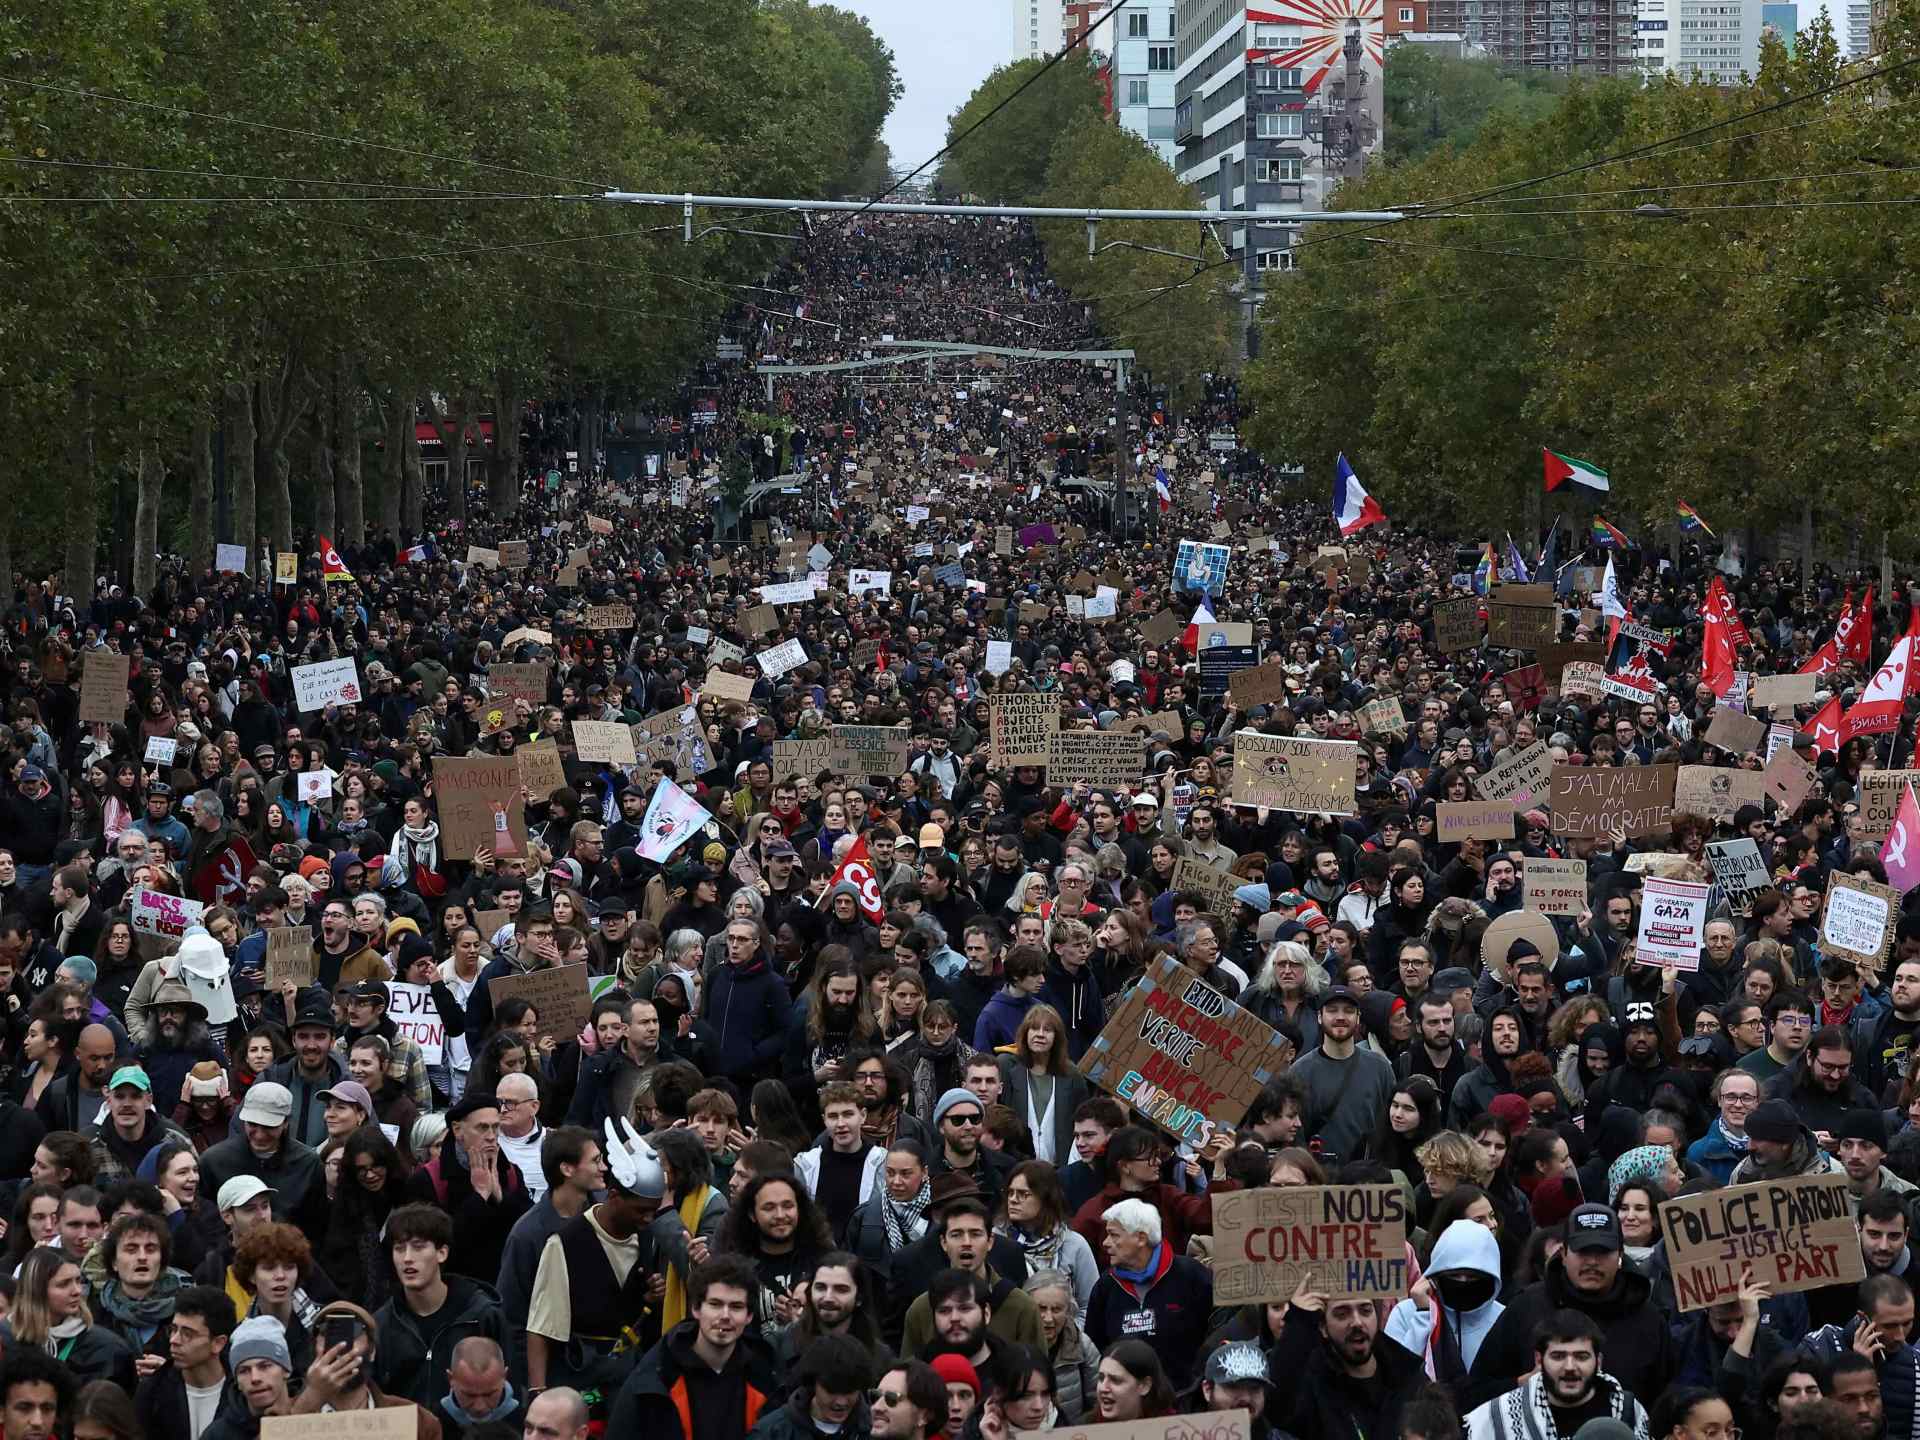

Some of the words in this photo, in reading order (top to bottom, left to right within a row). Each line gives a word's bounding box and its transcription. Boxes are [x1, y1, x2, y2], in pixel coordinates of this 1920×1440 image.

[997, 705, 1057, 715] FRAUDEURS
[997, 715, 1044, 726] ABJECTS
[997, 725, 1050, 736] CRAPULES
[997, 734, 1046, 746] HAINEUX
[998, 744, 1046, 756] ORDURES
[1484, 778, 1497, 791] LA
[1560, 773, 1605, 797] J'AI
[1609, 771, 1645, 795] MAL
[1602, 795, 1625, 809] MA
[1553, 806, 1672, 833] DÉMOCRATIE
[1707, 845, 1728, 859] LA
[1530, 888, 1546, 897] LES
[1654, 905, 1690, 921] GAZA
[1116, 1070, 1216, 1149] ENFANTS
[1323, 1188, 1405, 1224] NOUS
[1665, 1192, 1766, 1252] POLICE
[1769, 1184, 1849, 1229] PARTOUT
[1244, 1224, 1383, 1263] CONTRE
[1719, 1225, 1815, 1260] JUSTICE
[1215, 1254, 1279, 1299] CEUX
[1347, 1248, 1406, 1293] HAUT
[1678, 1261, 1755, 1310] NULLE
[1775, 1244, 1840, 1283] PART
